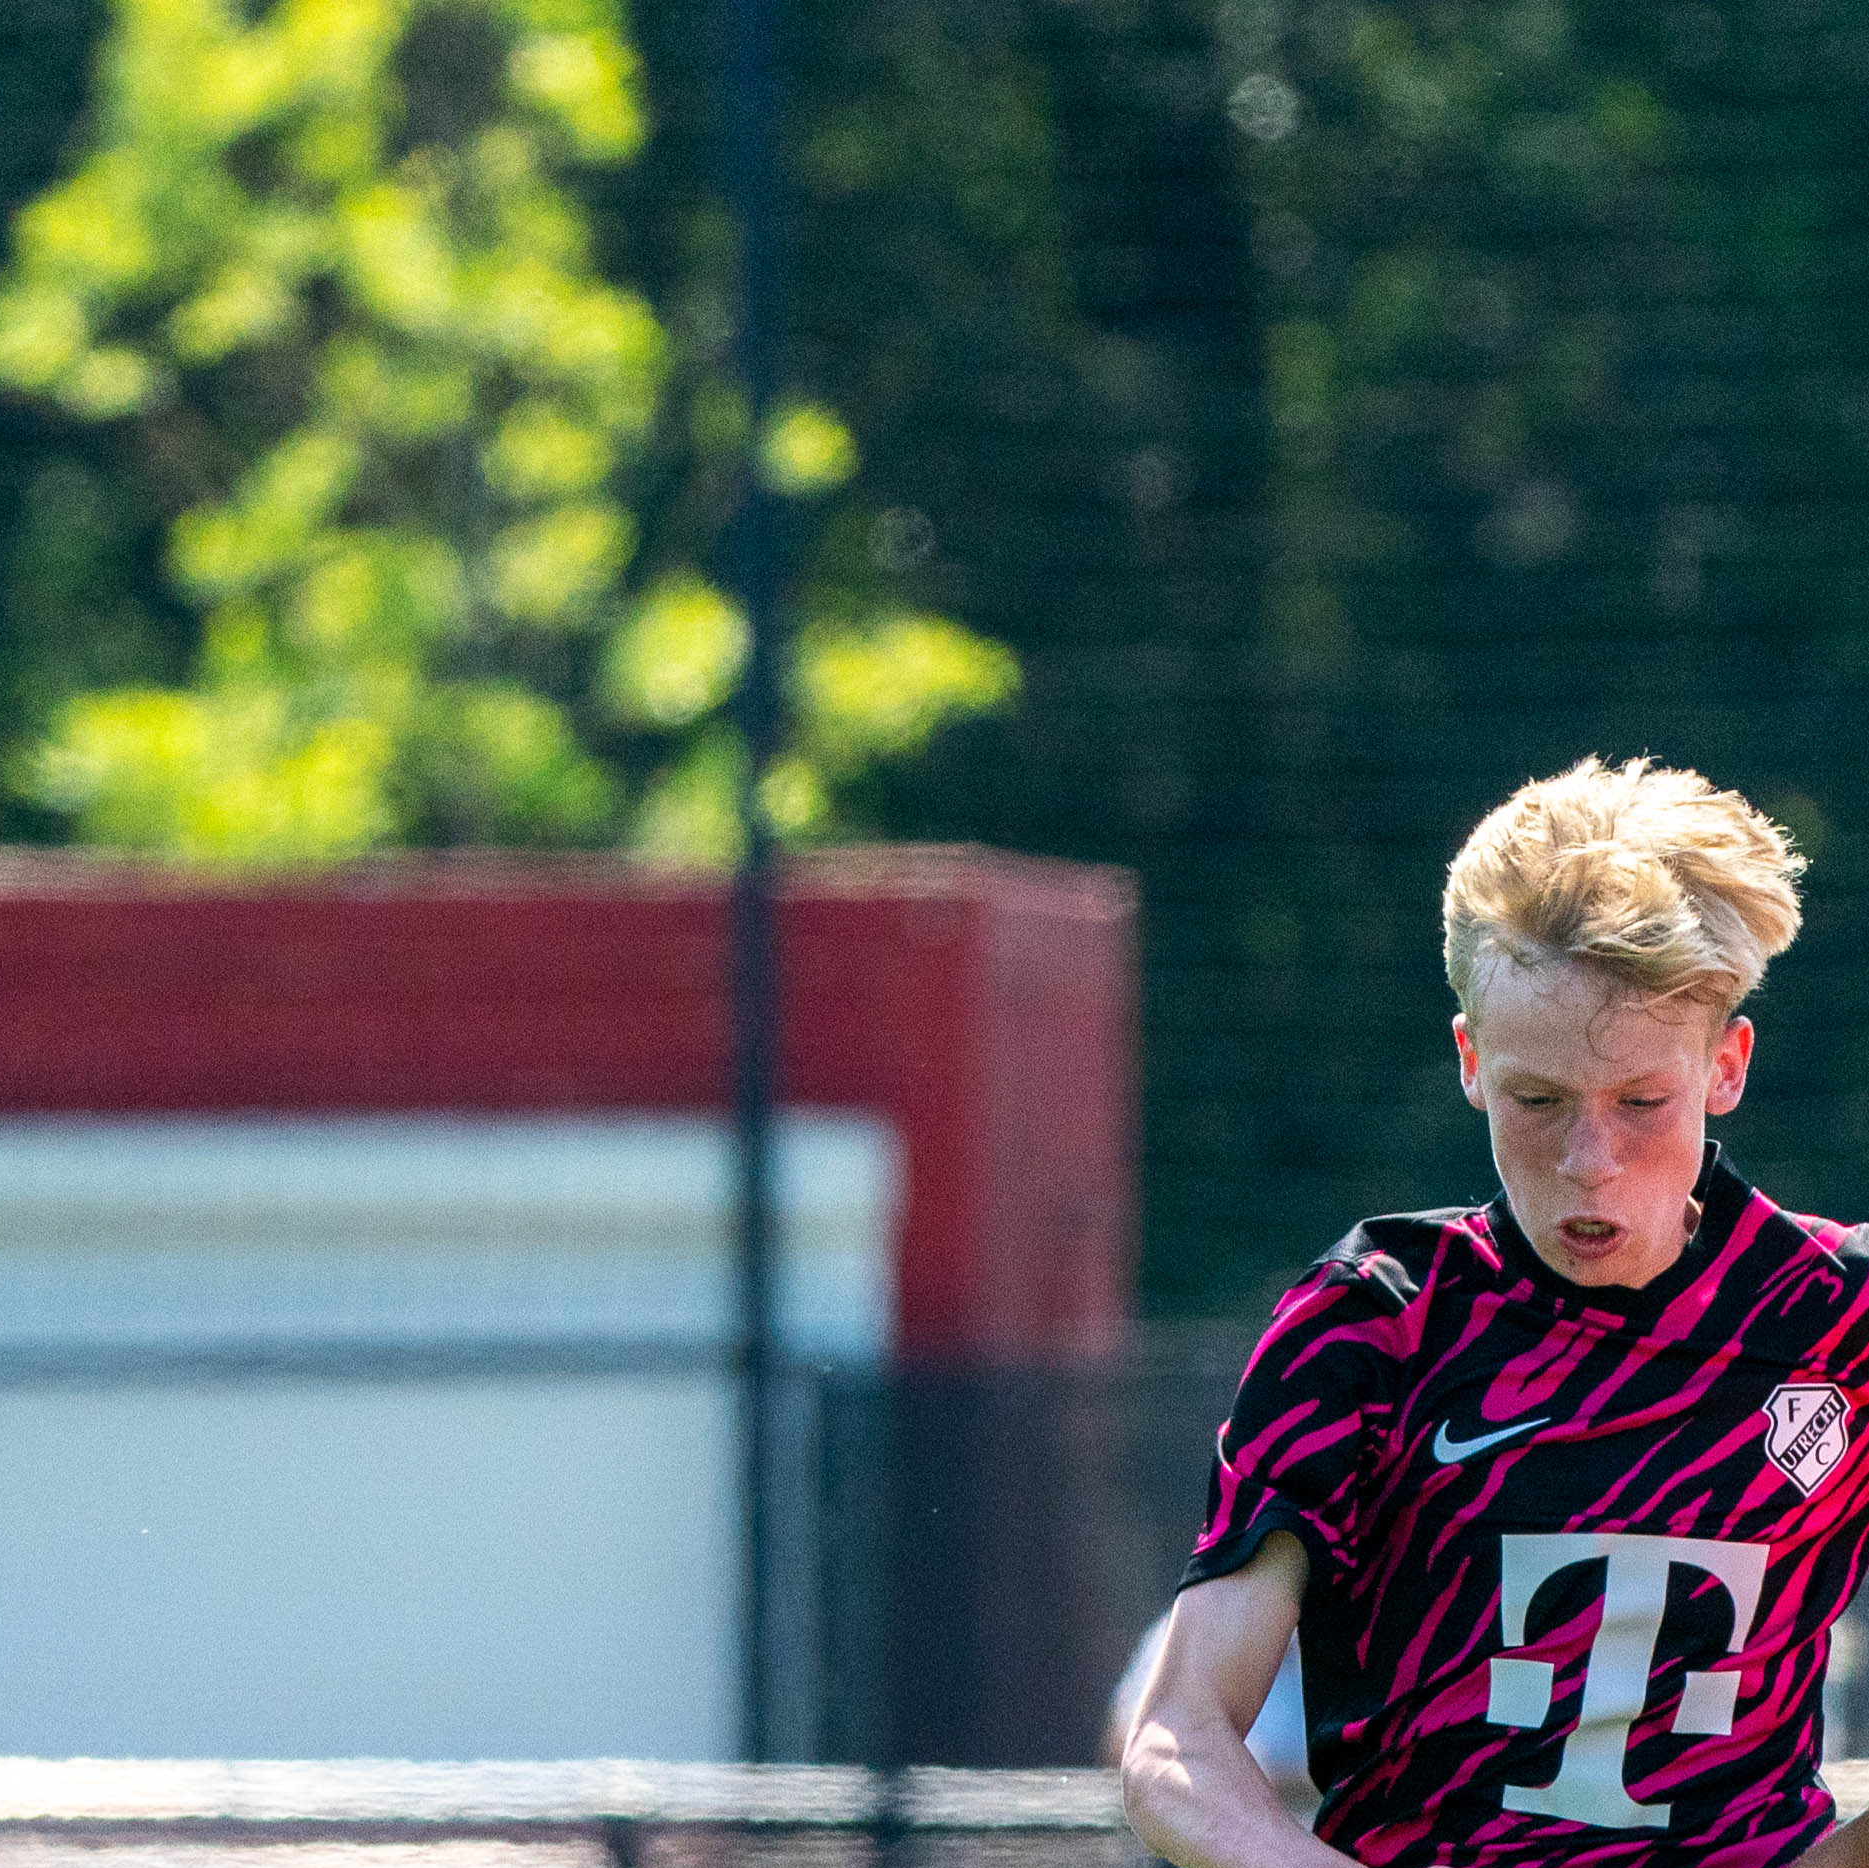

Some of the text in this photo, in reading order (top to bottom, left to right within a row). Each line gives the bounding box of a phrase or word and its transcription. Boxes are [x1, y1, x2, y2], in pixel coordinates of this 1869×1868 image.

[1780, 1393, 1842, 1470] UTRECHT
[1788, 1398, 1801, 1423] F
[1815, 1442, 1831, 1465] C
[1485, 1533, 1771, 1829] T
